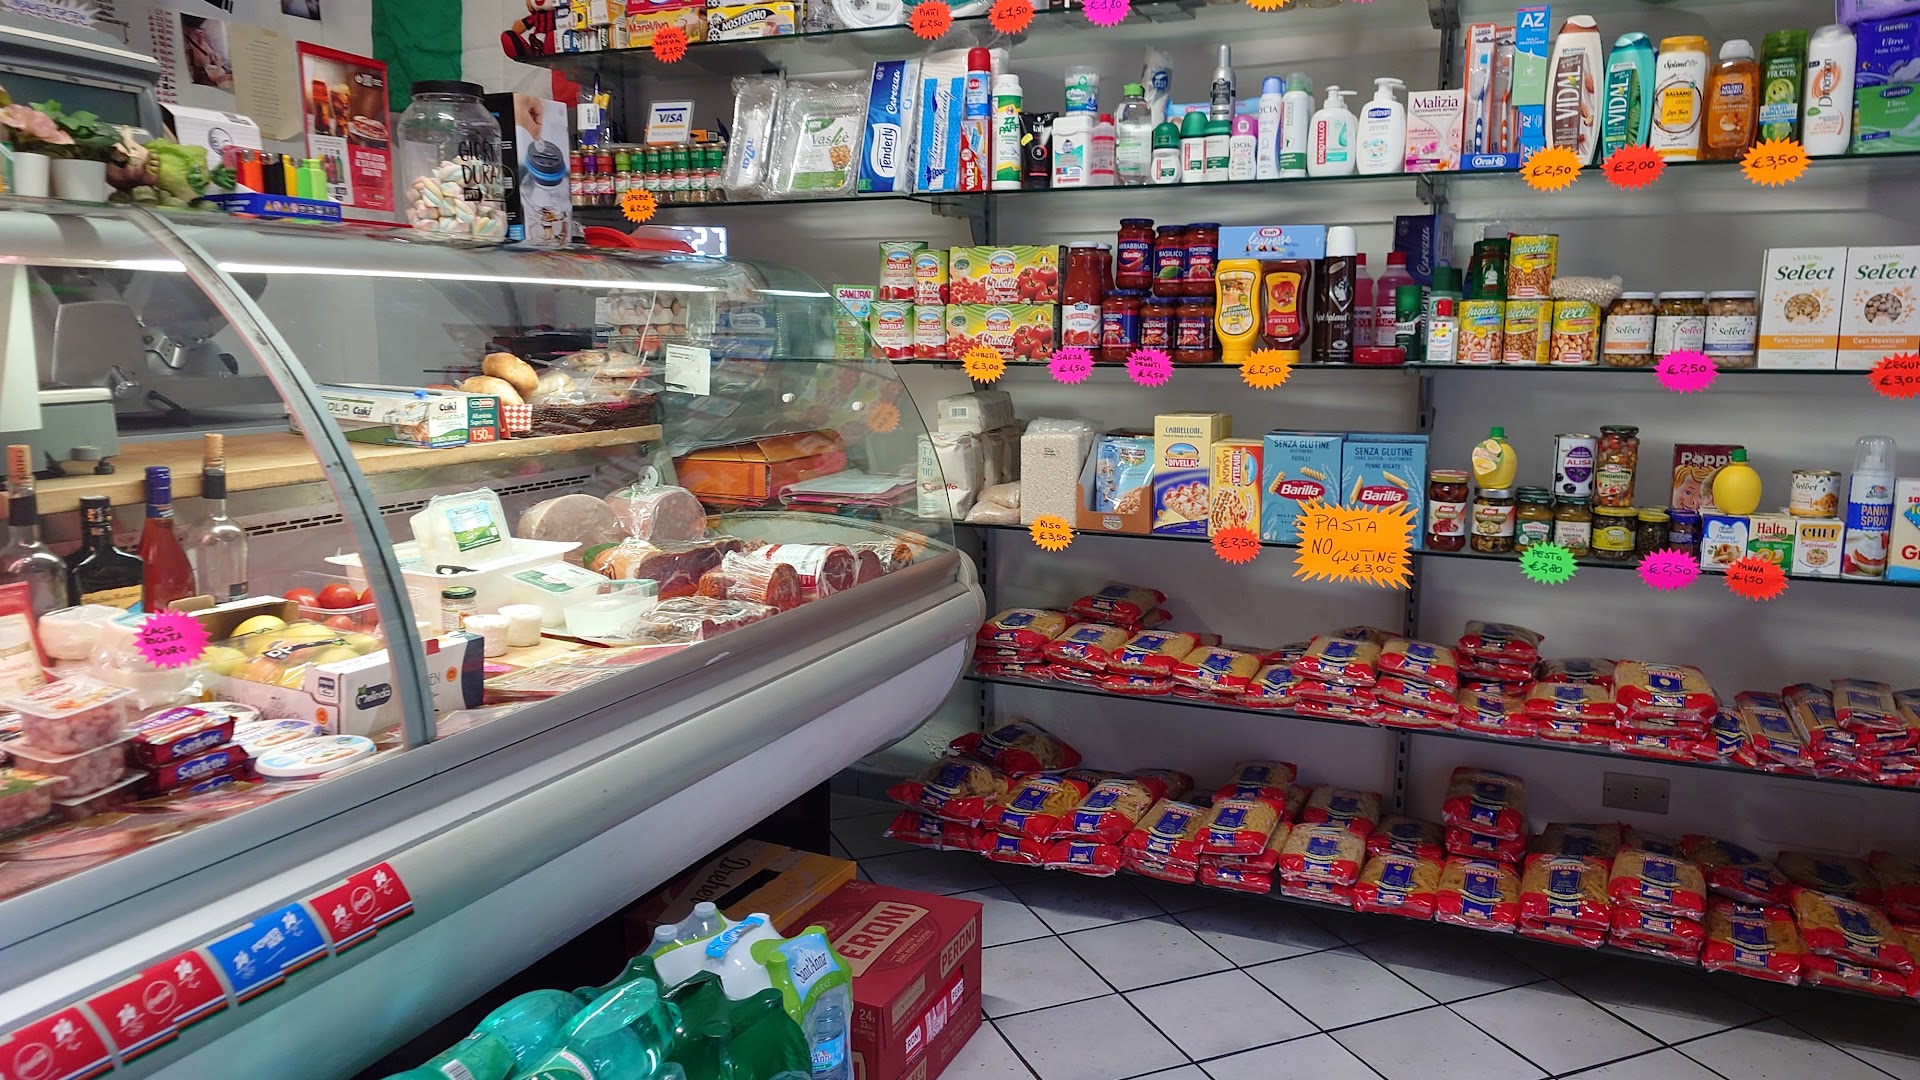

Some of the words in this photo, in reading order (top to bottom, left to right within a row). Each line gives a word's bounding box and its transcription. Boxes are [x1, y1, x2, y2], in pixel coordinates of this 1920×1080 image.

[722, 9, 766, 32] NOSTROMO
[1521, 13, 1545, 28] AZ
[1767, 69, 1797, 78] FRUCTIS
[1555, 65, 1580, 121] VIDAL
[1413, 96, 1459, 109] Malizia
[1607, 77, 1629, 125] VIDAL
[658, 113, 683, 123] VISA
[1317, 121, 1327, 165] BOROTALCO
[878, 126, 898, 174] Tenderly
[1612, 160, 1655, 173] €2,00
[1751, 154, 1798, 169] €3,50
[965, 161, 975, 191] VAPE
[1531, 165, 1572, 177] €2,50
[1158, 250, 1183, 258] BASILICO
[1774, 262, 1837, 281] Select
[1855, 261, 1919, 281] Select
[839, 289, 872, 299] SAMURAI
[1560, 305, 1586, 319] ceci
[1614, 326, 1641, 335] Select
[1719, 326, 1747, 336] Select
[1056, 353, 1083, 361] SALSA
[972, 361, 999, 372] €3,00
[1249, 365, 1282, 375] €2,50
[1666, 364, 1707, 376] €2,50
[352, 406, 373, 417] Cuki
[438, 403, 457, 412] Cuki
[1165, 426, 1201, 435] CANNELLONI
[1273, 440, 1298, 450] SENZA
[1299, 440, 1331, 450] GLUTINE
[1354, 446, 1381, 457] SENZA
[1382, 447, 1414, 457] GLUTINE
[1168, 459, 1197, 468] DIVELLA
[1232, 454, 1241, 485] DIVELLA
[1280, 483, 1320, 495] Barilla
[1361, 490, 1401, 502] Barilla
[1861, 505, 1889, 516] PANNA
[1040, 519, 1061, 529] RISO
[1314, 513, 1377, 534] PASTA
[1861, 516, 1888, 527] SPRAY
[1757, 522, 1787, 535] Halta
[1038, 532, 1068, 543] €3,50
[1218, 538, 1256, 550] €2,50
[1311, 538, 1333, 555] NO
[1331, 549, 1397, 564] GLUTINE
[1532, 550, 1562, 560] PESTO
[1349, 564, 1394, 575] €3,00
[1649, 562, 1692, 577] €2,50
[1737, 562, 1764, 574] PANNA
[171, 731, 221, 758] Sottilette
[176, 755, 228, 781] Sottilette
[1550, 864, 1584, 872] DIVELLA
[838, 903, 918, 961] ERONI
[941, 922, 976, 974] PERONI
[793, 951, 827, 984] Sant'Anna
